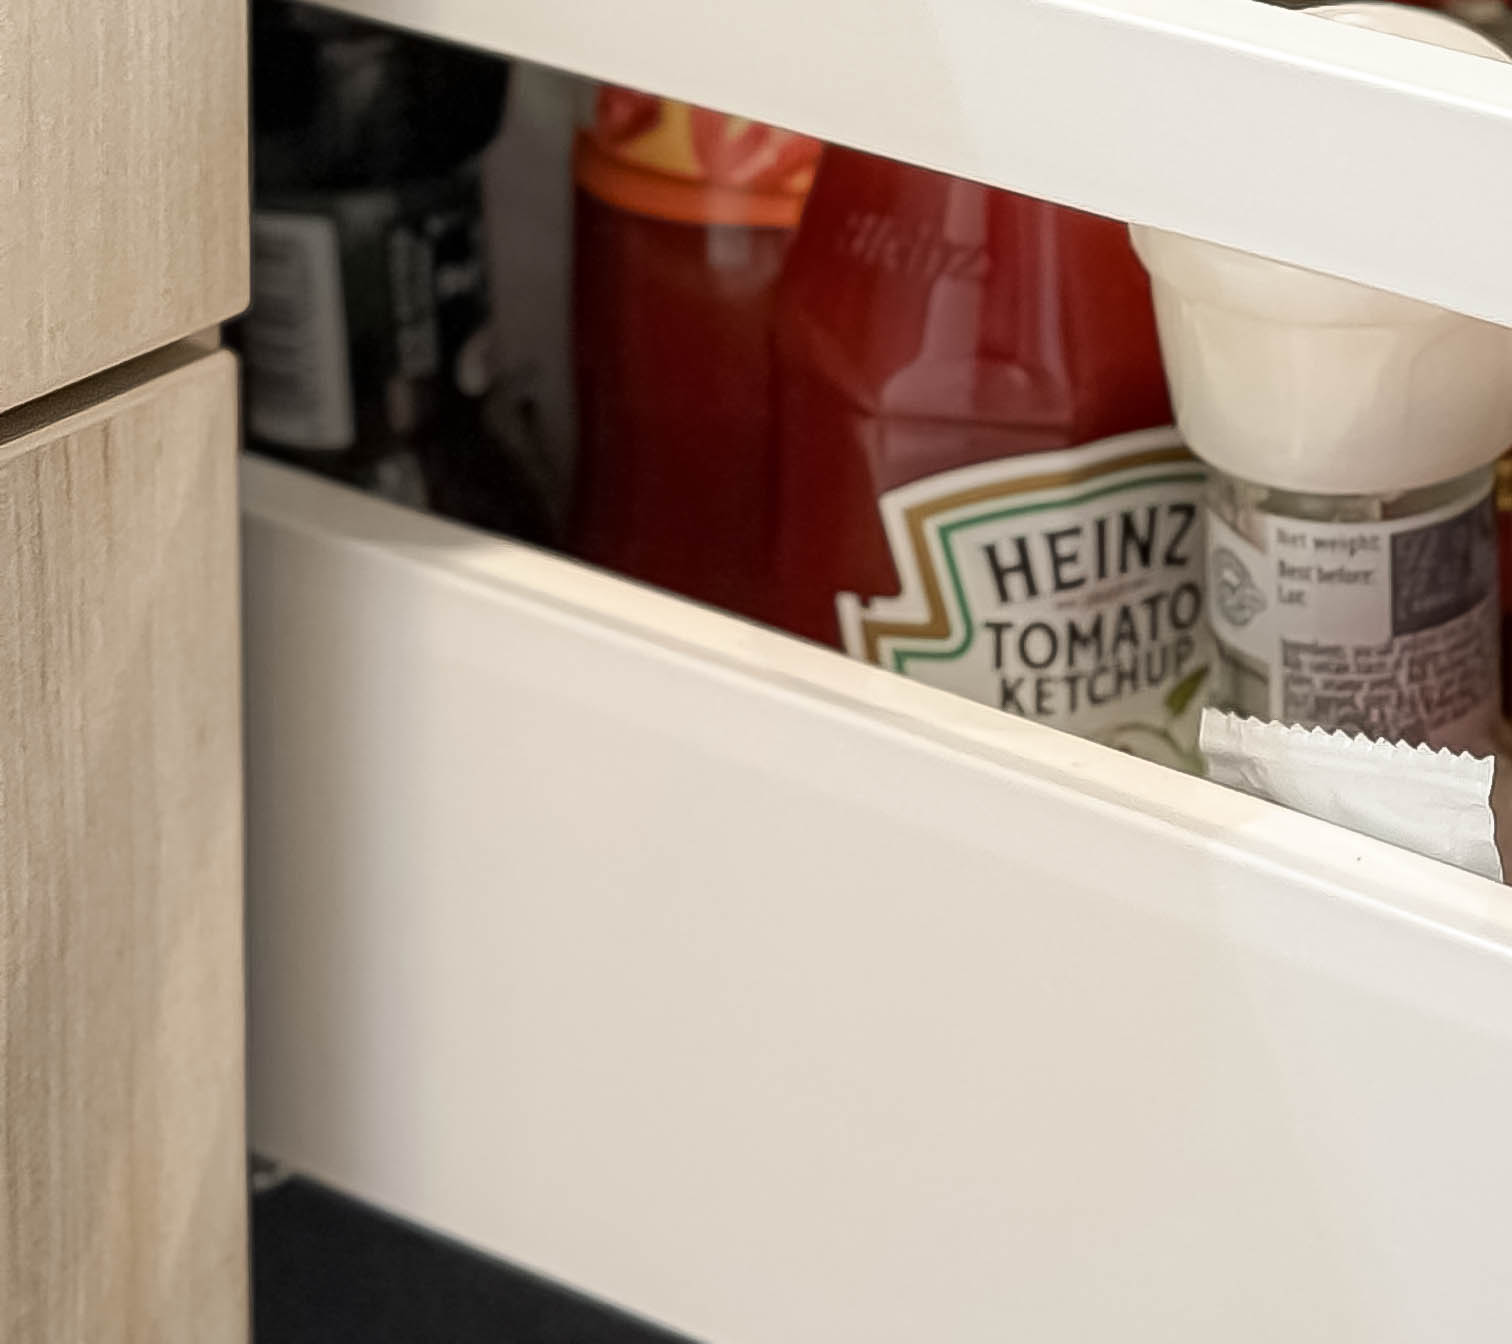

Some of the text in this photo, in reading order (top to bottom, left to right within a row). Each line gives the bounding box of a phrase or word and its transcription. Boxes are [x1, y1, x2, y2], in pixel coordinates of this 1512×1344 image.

[982, 501, 1198, 603] HEINZ
[982, 581, 1202, 670] TOMATO
[1000, 635, 1195, 715] KETCHUP
